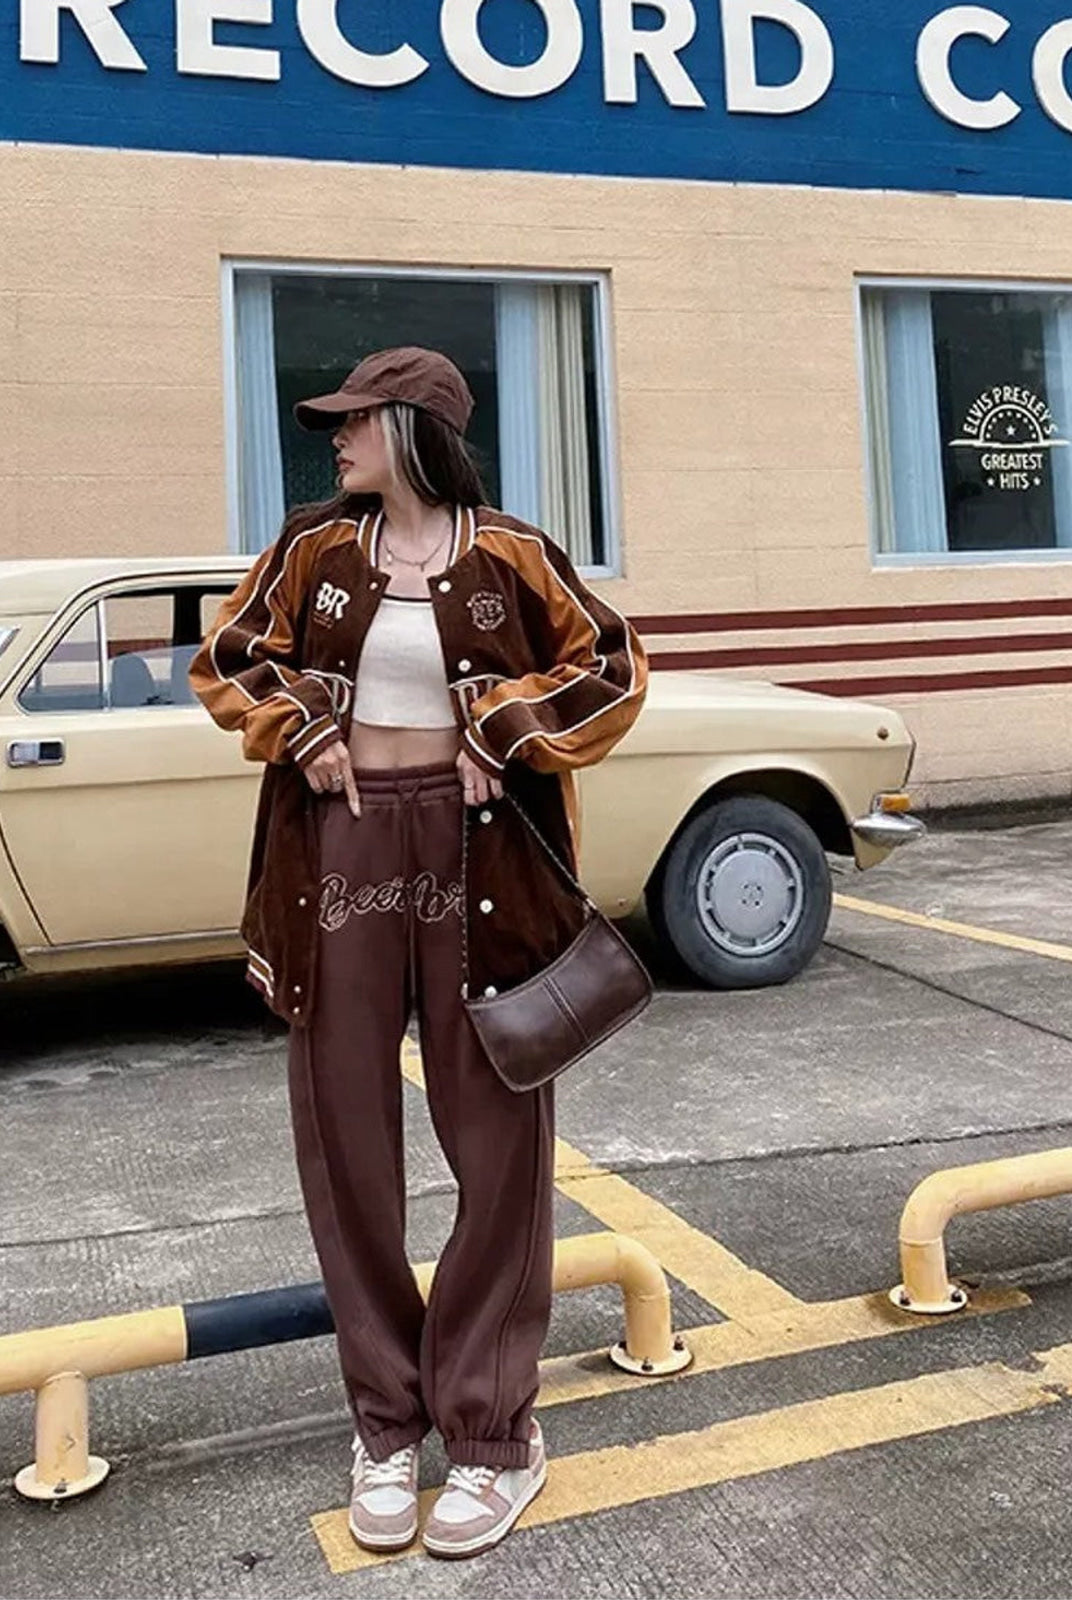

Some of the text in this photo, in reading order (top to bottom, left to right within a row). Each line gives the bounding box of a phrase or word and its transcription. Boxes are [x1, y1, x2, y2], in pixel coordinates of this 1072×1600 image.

[963, 385, 1059, 435] ELVIS PRESLEYS
[981, 453, 1043, 470] GREATEST
[1000, 473, 1030, 489] HITS
[315, 581, 351, 620] BR
